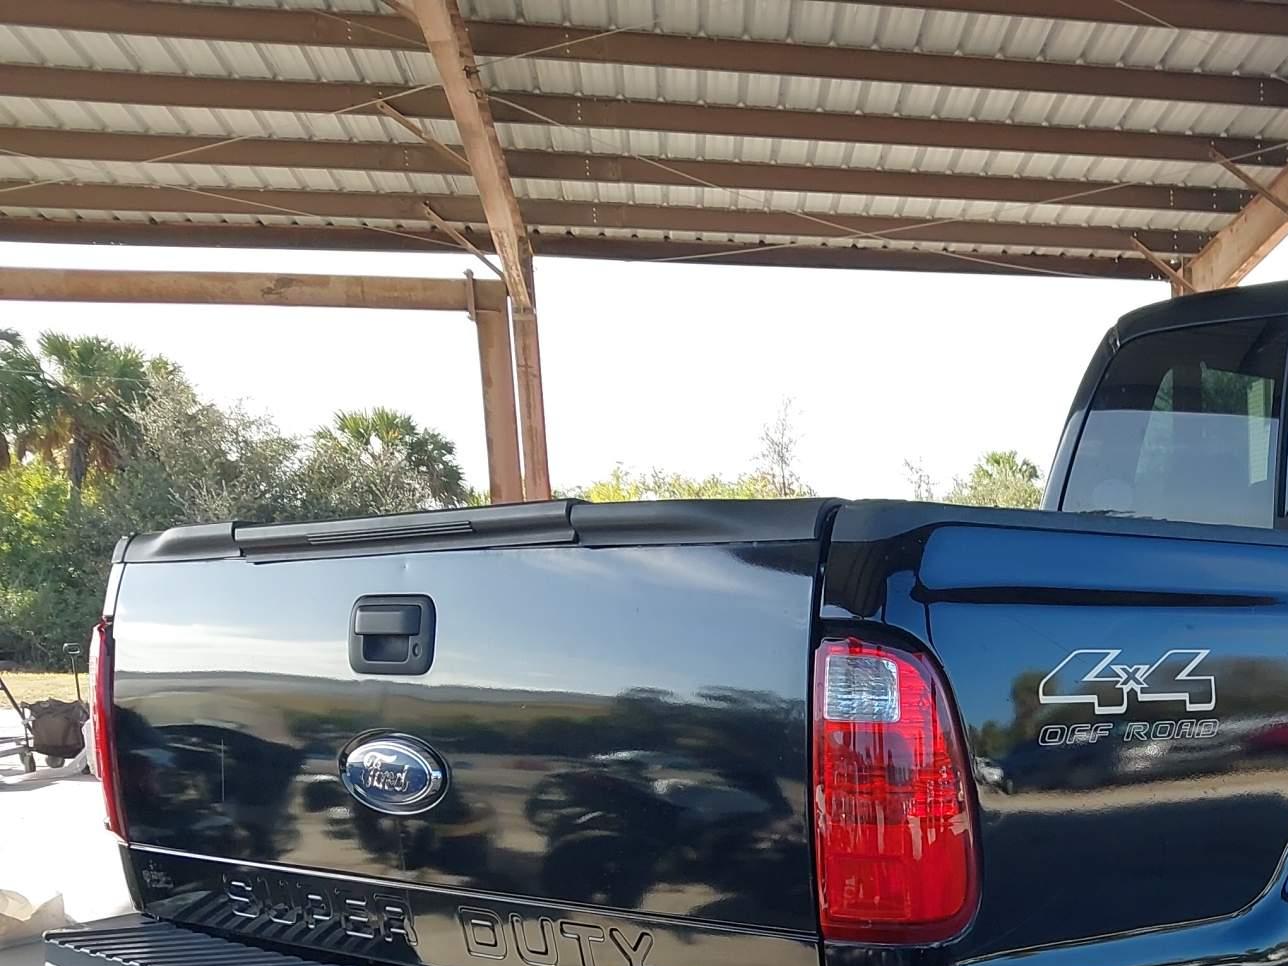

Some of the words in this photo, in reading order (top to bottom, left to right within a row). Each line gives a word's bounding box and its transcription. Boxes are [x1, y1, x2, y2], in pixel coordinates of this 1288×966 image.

[1039, 723, 1113, 746] OFF
[1124, 719, 1219, 741] ROAD
[361, 752, 409, 792] Ford
[223, 873, 417, 946] SUPER
